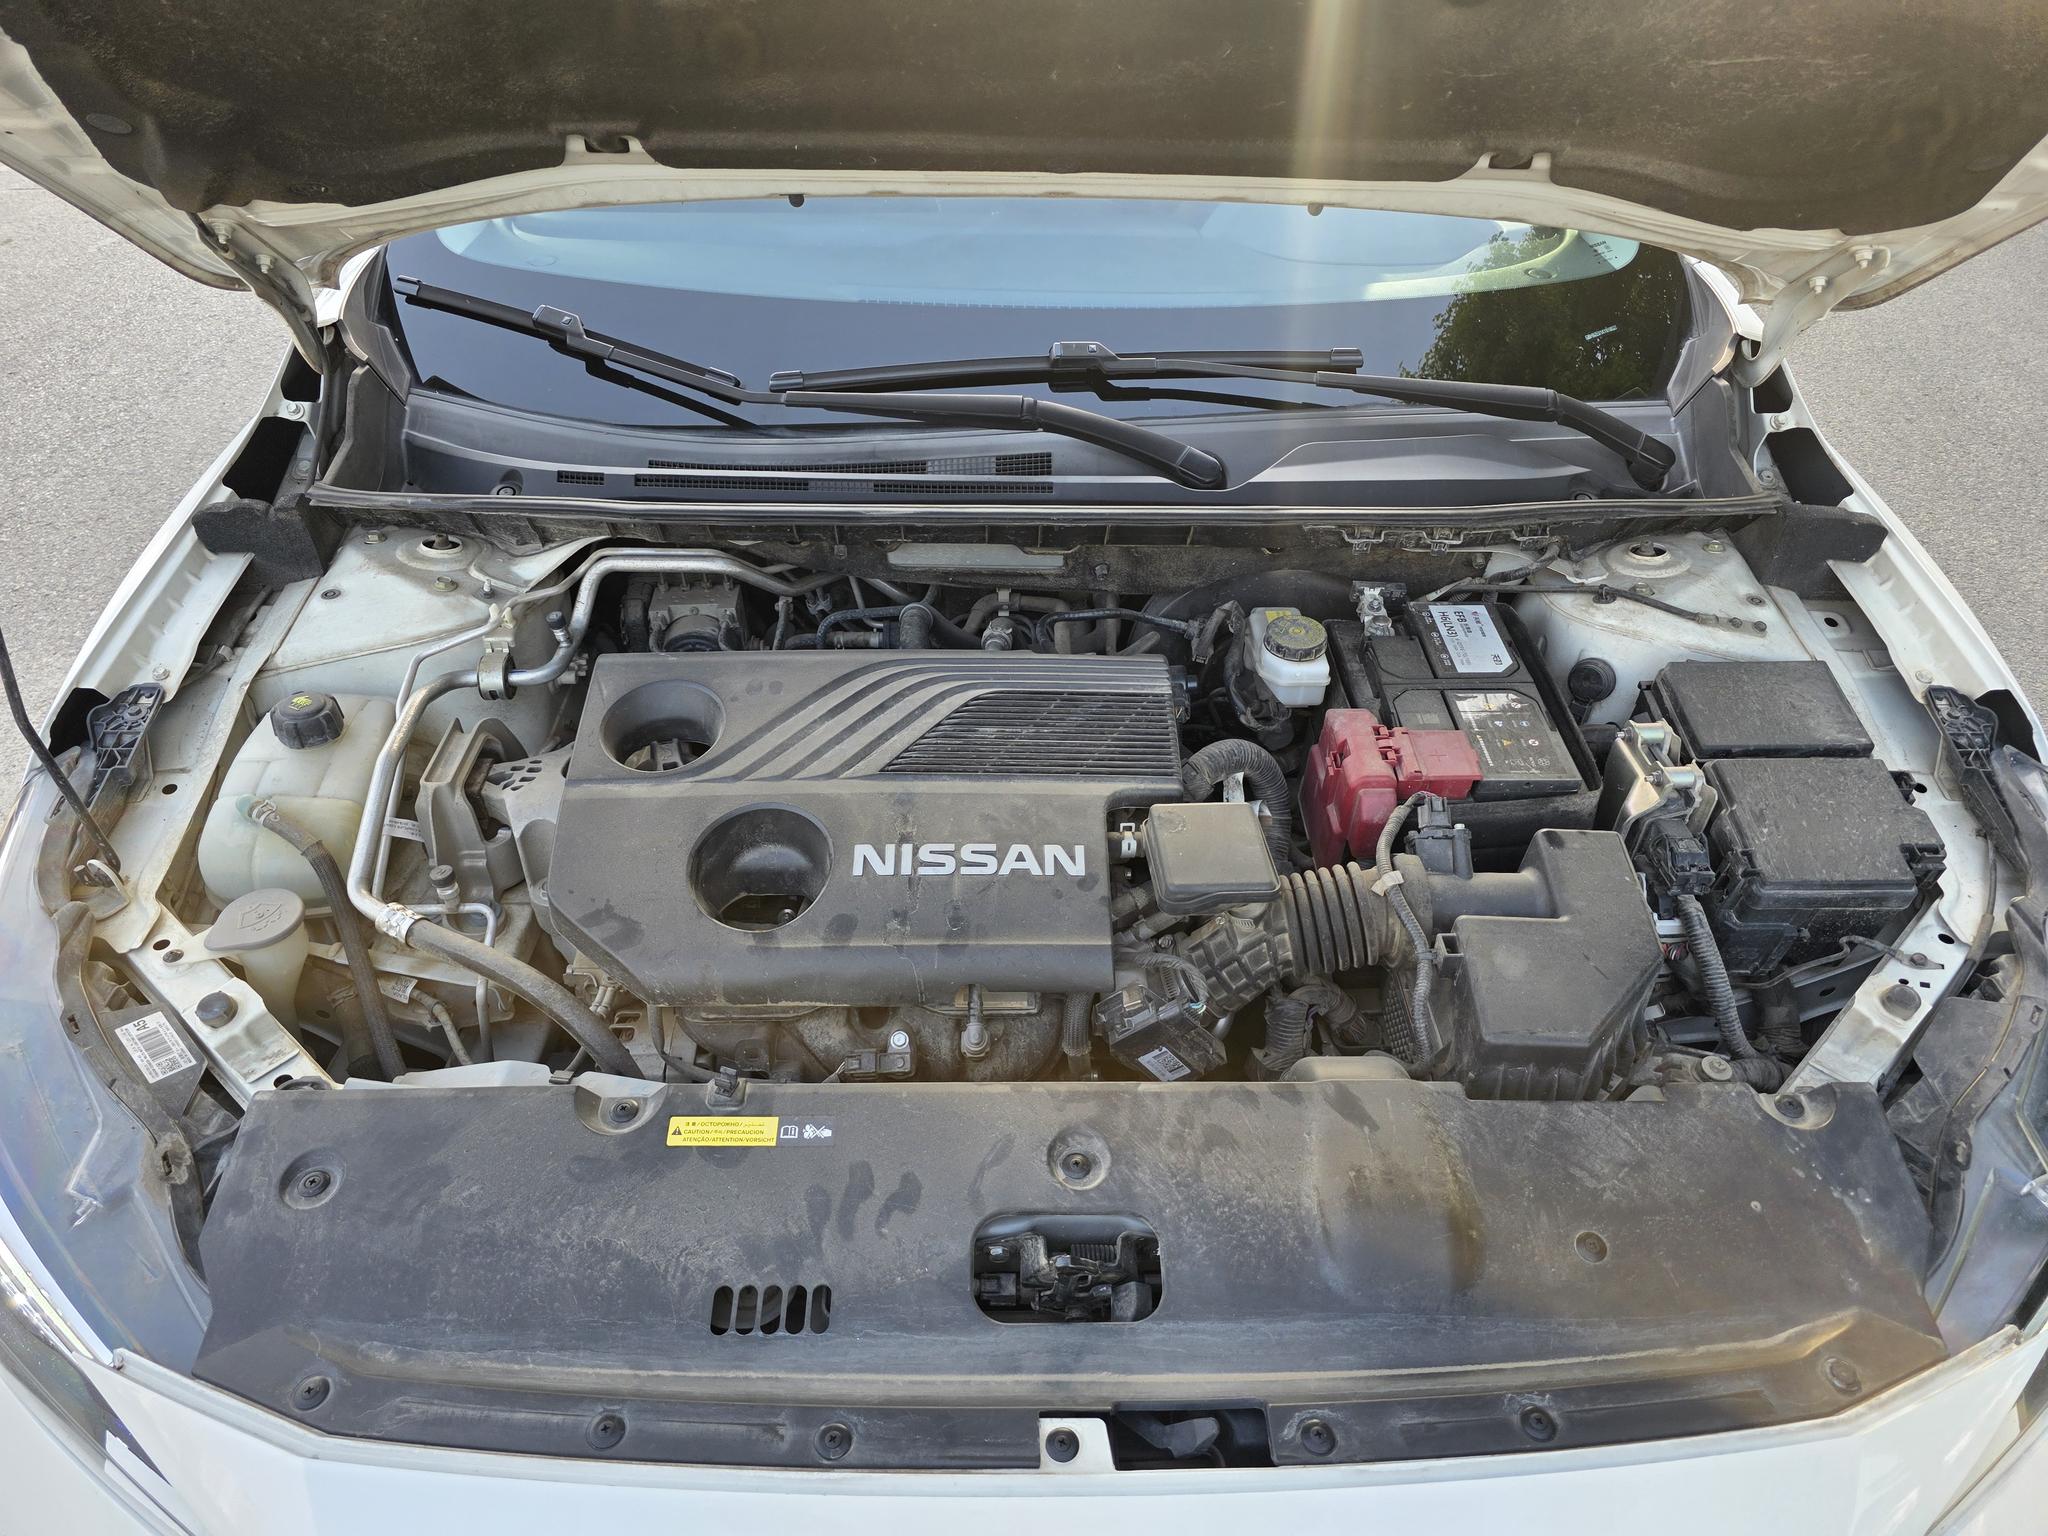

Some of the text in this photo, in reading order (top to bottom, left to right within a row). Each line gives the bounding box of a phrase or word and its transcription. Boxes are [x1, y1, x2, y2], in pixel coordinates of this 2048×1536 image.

[1438, 611, 1459, 638] H6(LN3)
[1454, 611, 1468, 623] EFB
[852, 843, 1086, 876] NISSAN
[132, 1019, 150, 1031] A5
